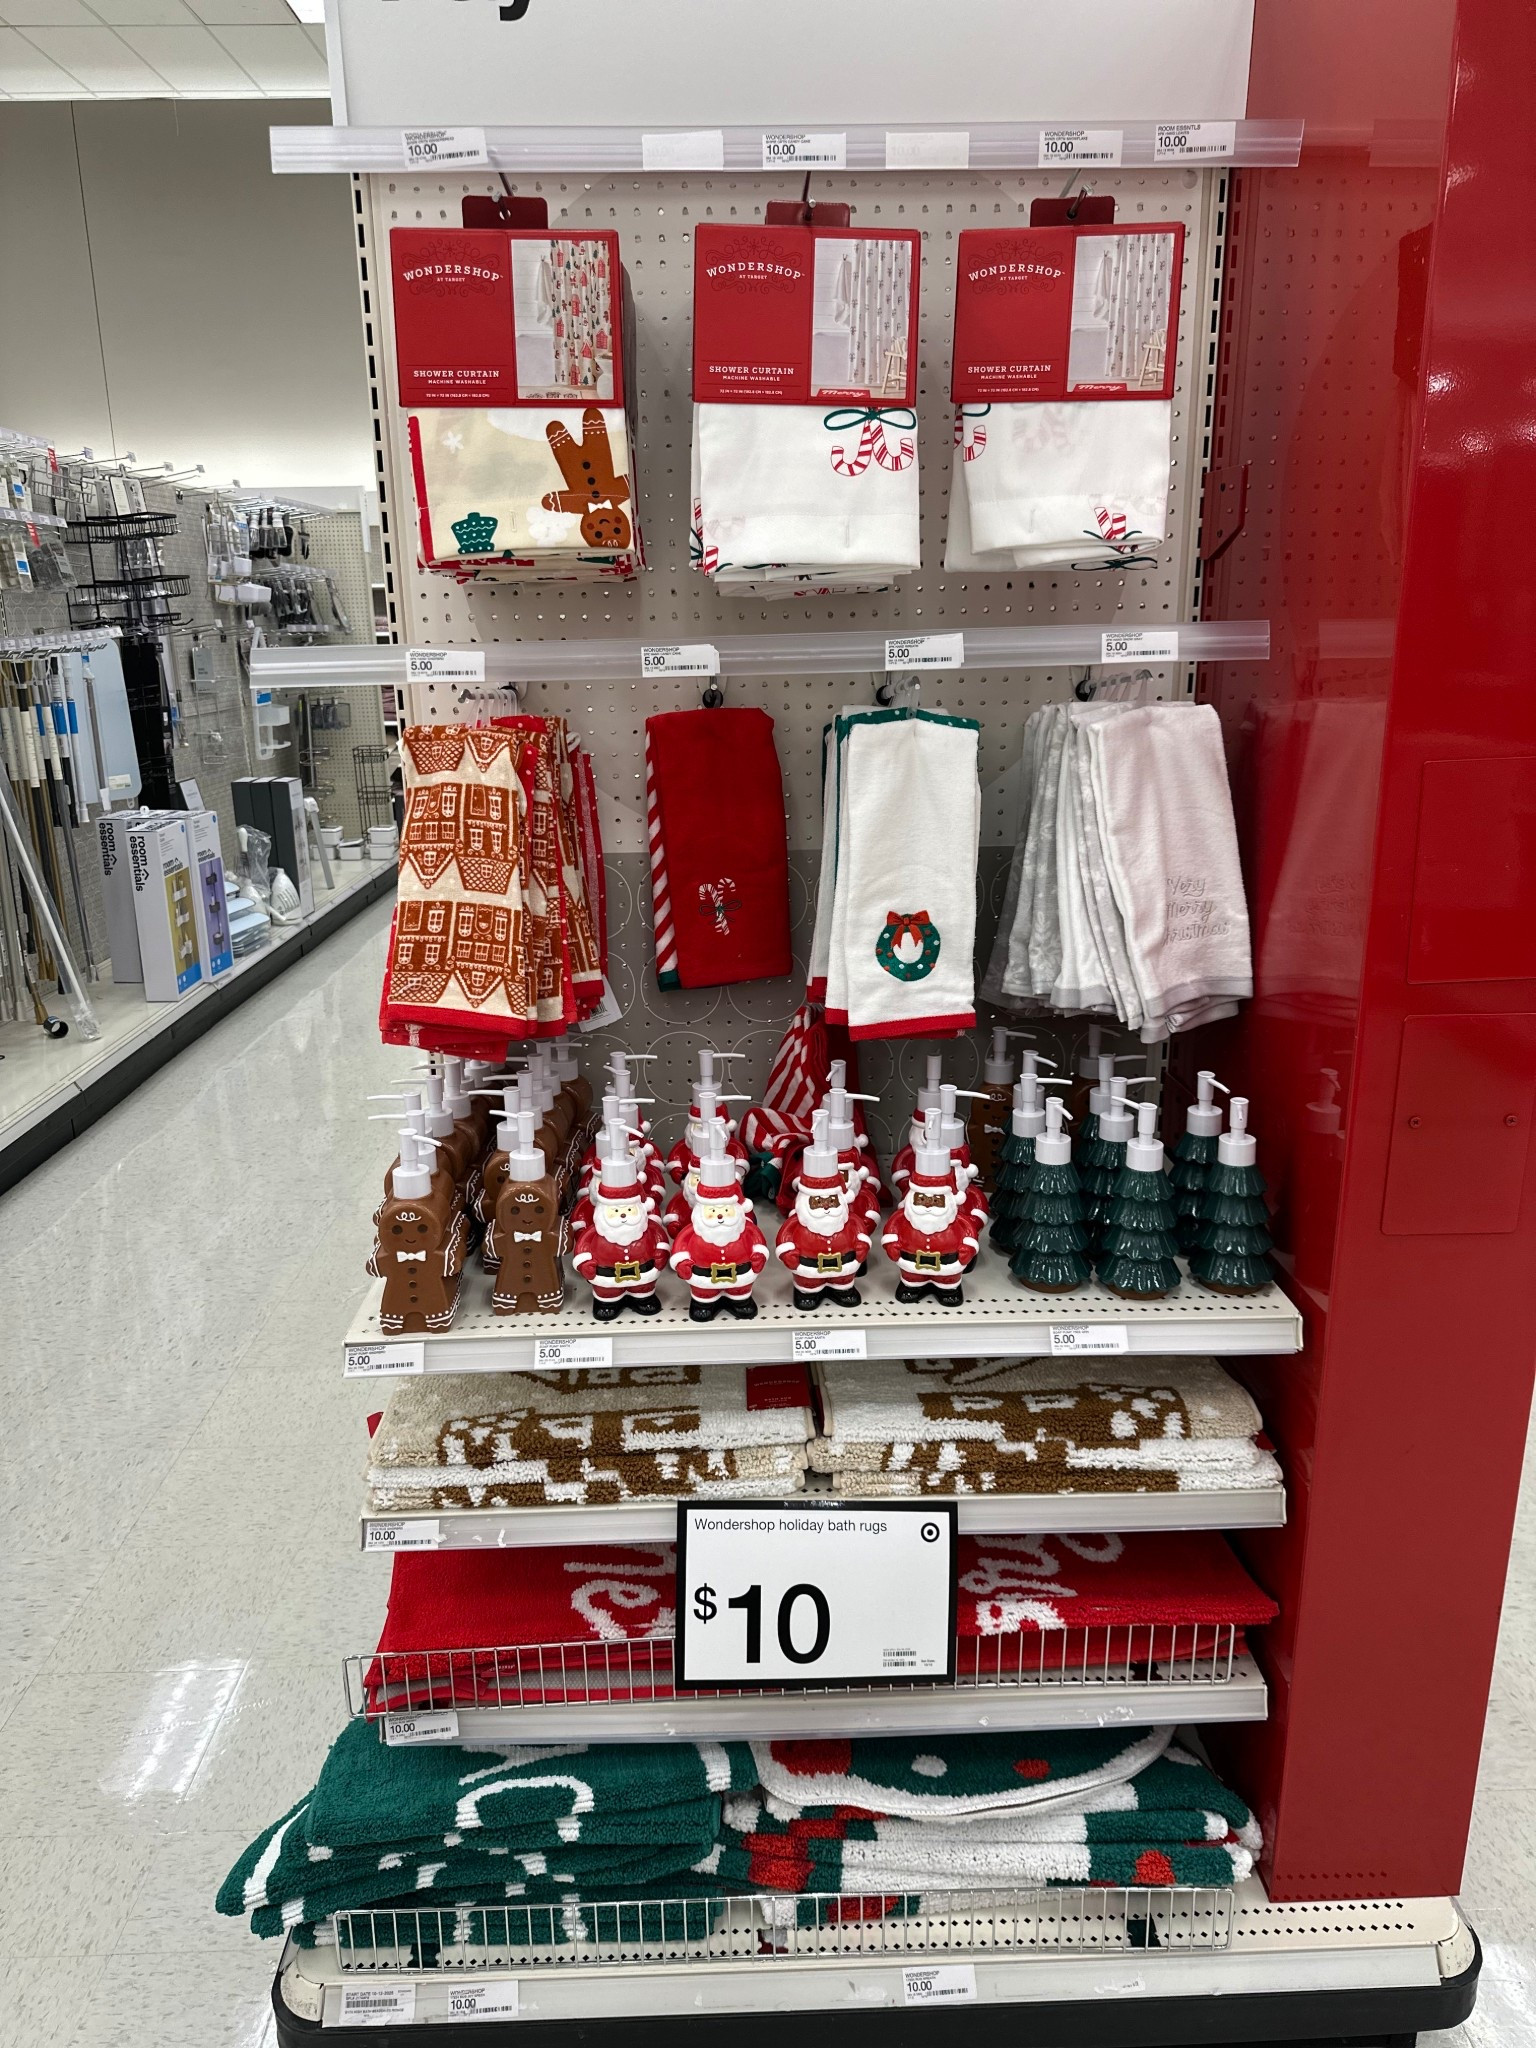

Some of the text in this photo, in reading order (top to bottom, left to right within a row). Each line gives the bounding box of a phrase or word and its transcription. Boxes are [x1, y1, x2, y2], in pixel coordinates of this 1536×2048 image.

[1044, 141, 1074, 153] 10.00
[1158, 136, 1187, 148] 10.00
[408, 143, 438, 157] 10.00
[766, 144, 796, 156] 10.00
[403, 264, 500, 282] WONDERSHOP
[706, 262, 801, 280] WONDERSHOP
[968, 263, 1061, 281] WONDERSHOP
[413, 370, 500, 378] SHOWER CURTAIN
[709, 366, 794, 375] SHOWER CURTAIN
[967, 364, 1051, 374] SHOWER CURTAIN
[1106, 641, 1127, 651] 5.00
[888, 648, 910, 658] 5.00
[411, 661, 432, 671] 5.00
[644, 656, 665, 666] 5.00
[106, 822, 116, 852] room
[99, 822, 113, 876] essentials
[137, 836, 147, 866] room
[130, 836, 145, 891] essentials
[1167, 901, 1214, 923] Merry
[796, 1340, 816, 1349] 5.00
[1054, 1335, 1075, 1344] 5.00
[540, 1348, 560, 1358] 5.00
[348, 1356, 370, 1366] 5.00
[694, 1518, 888, 1535] Wondershop holiday bath rugs
[369, 1531, 396, 1541] 10.00
[390, 1722, 415, 1734] 10.00
[905, 1970, 940, 1978] WONDERSHOP
[907, 1980, 932, 1992] 10.00
[451, 1998, 476, 2010] 10.00
